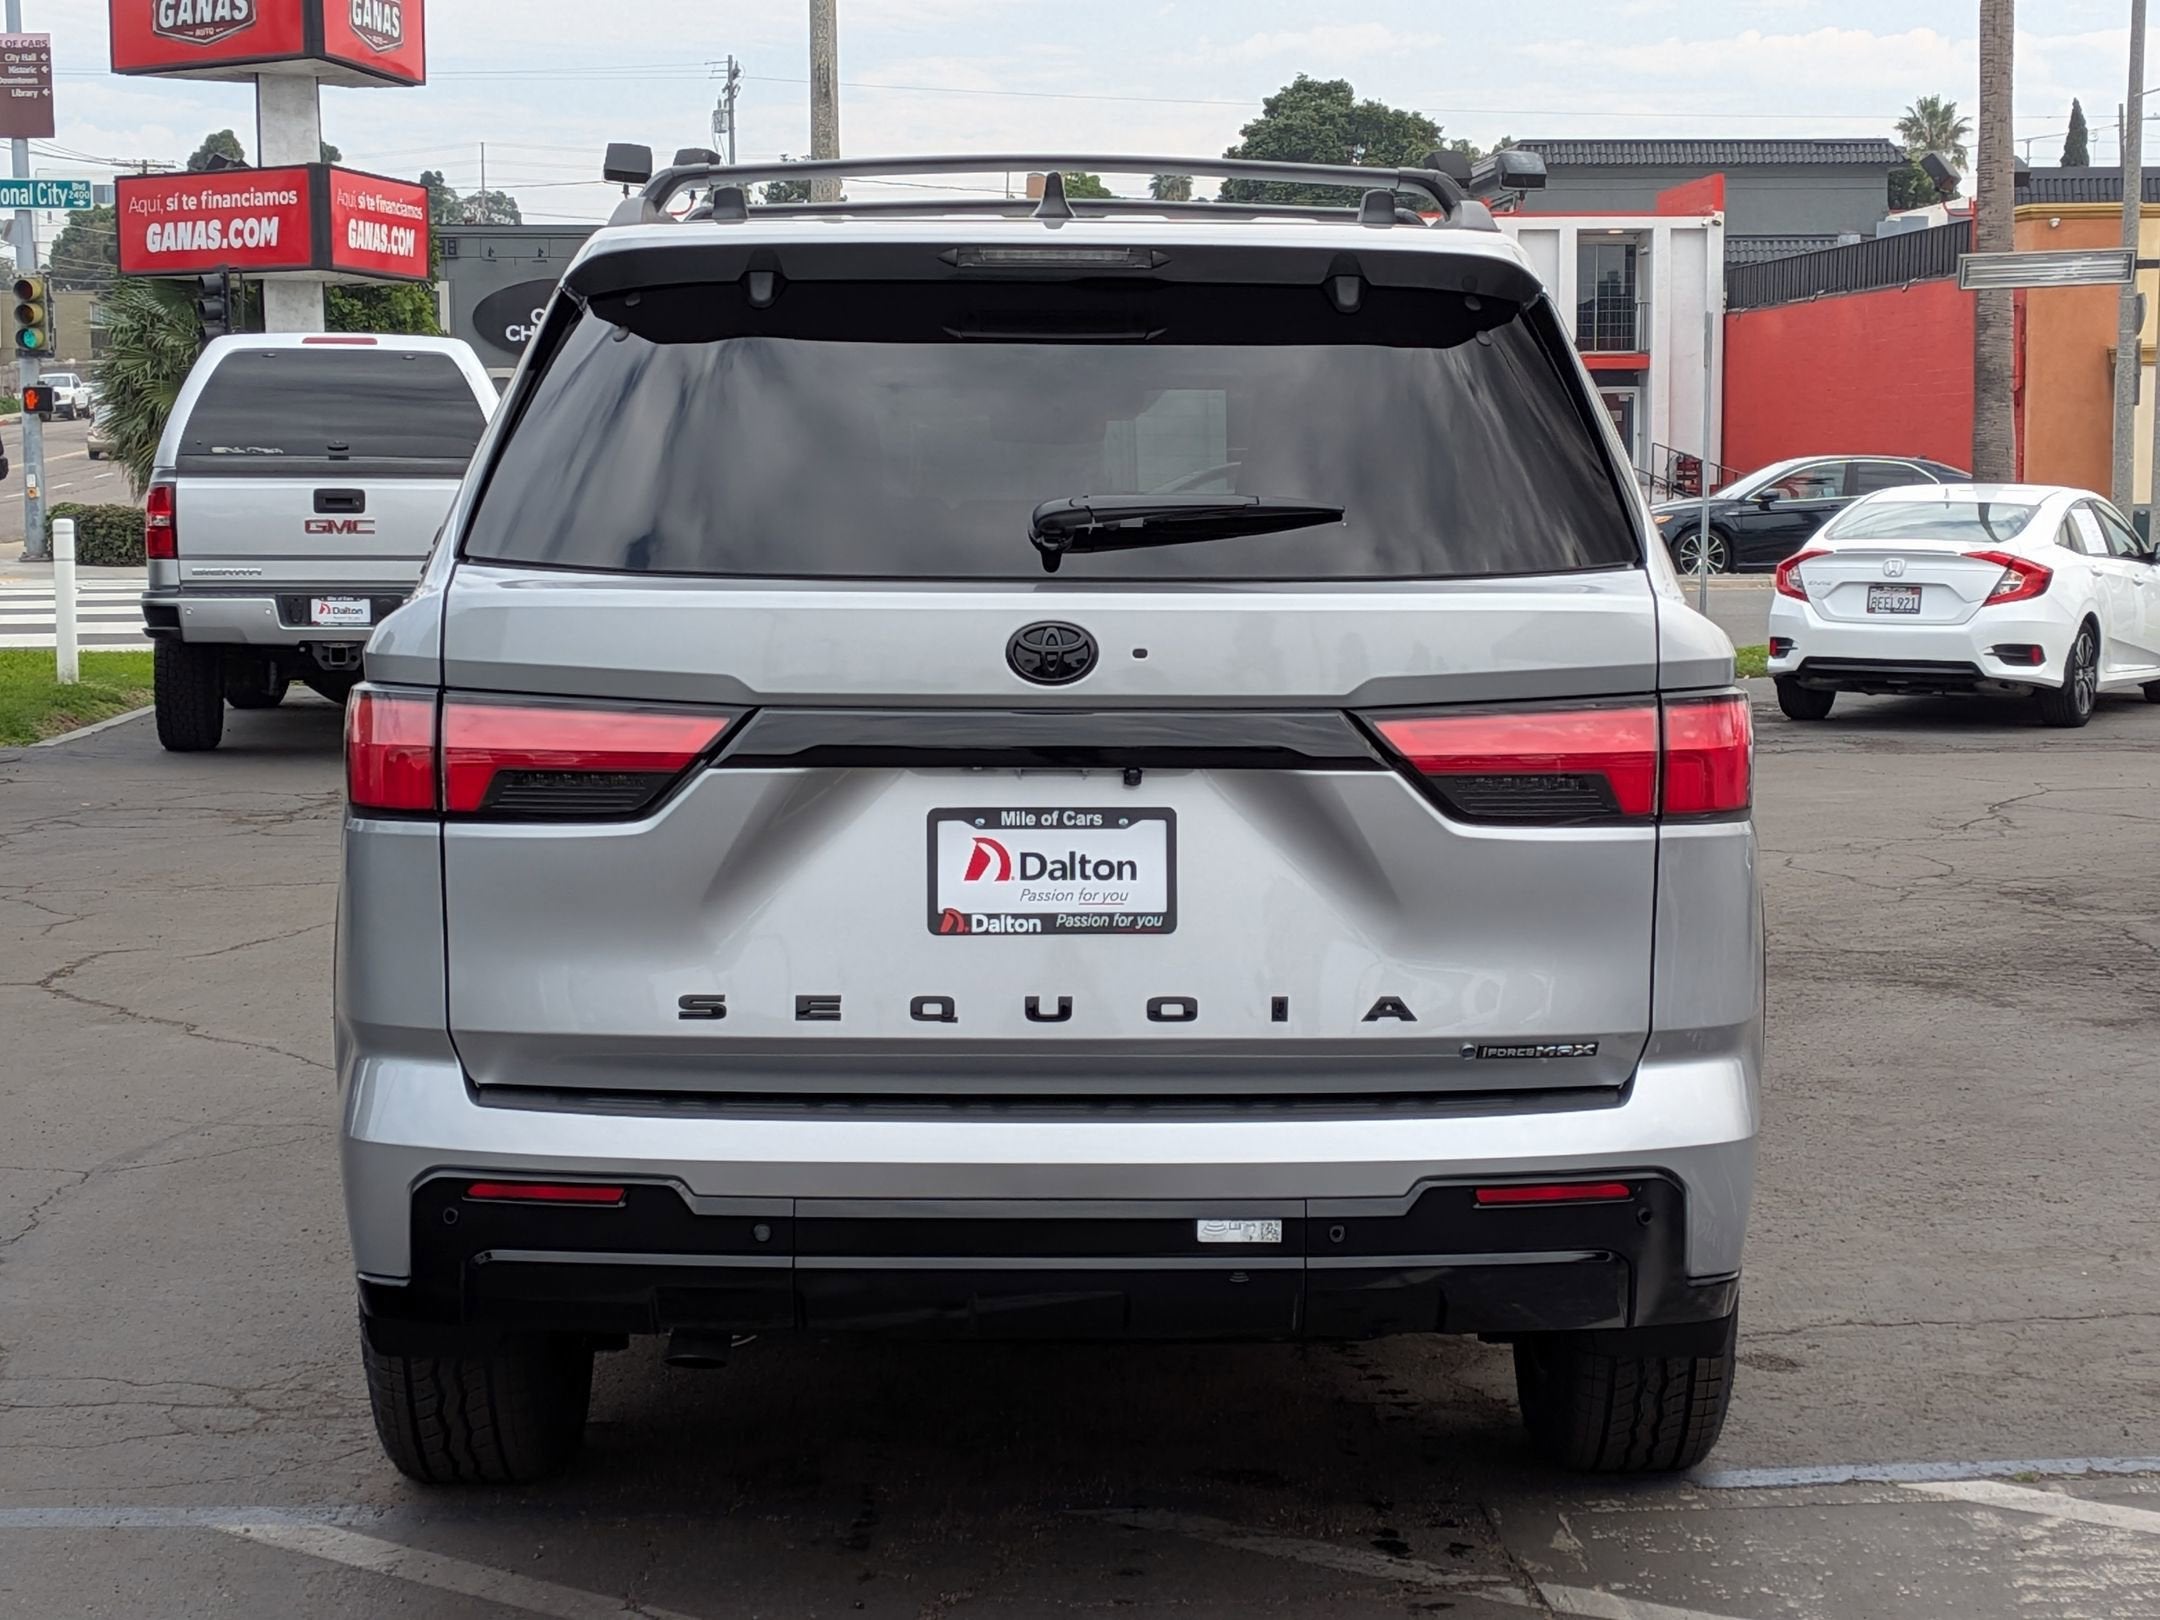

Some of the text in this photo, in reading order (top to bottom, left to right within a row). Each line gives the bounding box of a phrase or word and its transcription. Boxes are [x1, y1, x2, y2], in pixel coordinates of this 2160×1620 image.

[159, 0, 249, 28] GANAS
[352, 0, 400, 38] GANAS
[5, 40, 48, 48] OF CARS
[4, 53, 37, 63] City Hall
[11, 88, 38, 99] Library
[37, 182, 68, 207] City
[68, 190, 90, 200] 2400
[128, 186, 298, 216] Aquí, sí te financiamos
[146, 216, 279, 253] GANAS.COM
[348, 218, 416, 258] GANAS.COM
[304, 519, 376, 535] GMC
[1001, 811, 1103, 826] Mile of Cars
[1019, 851, 1138, 881] Dalton
[1020, 888, 1129, 905] Passion for you
[971, 913, 1163, 933] Dalton Passion for you
[678, 994, 1418, 1024] SEQUOIA
